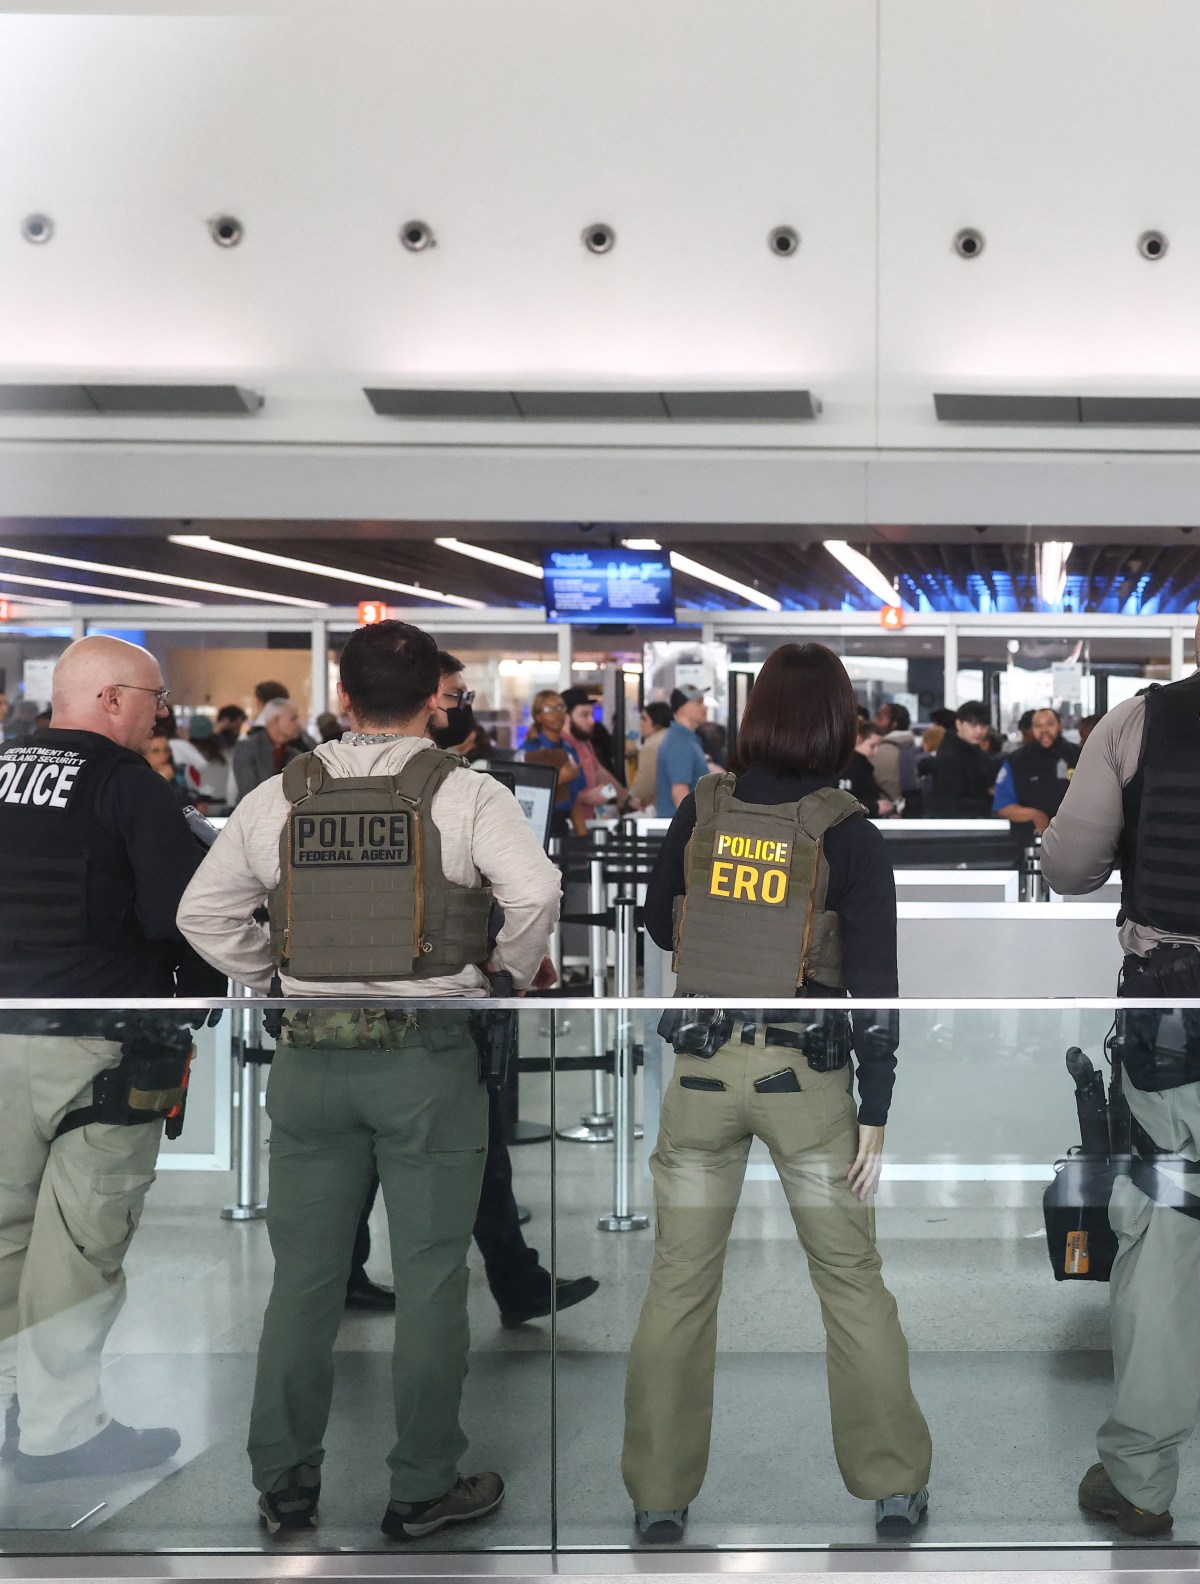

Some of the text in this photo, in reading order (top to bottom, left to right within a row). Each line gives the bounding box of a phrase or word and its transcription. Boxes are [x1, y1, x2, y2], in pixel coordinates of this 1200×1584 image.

[0, 754, 86, 766] MELAND SECURITY
[4, 746, 64, 756] DEPARTMENT
[0, 761, 80, 808] OLICE
[298, 815, 405, 849] POLICE
[298, 848, 404, 862] FEDERAL AGENT
[717, 834, 788, 863] POLICE
[710, 861, 787, 904] ERO
